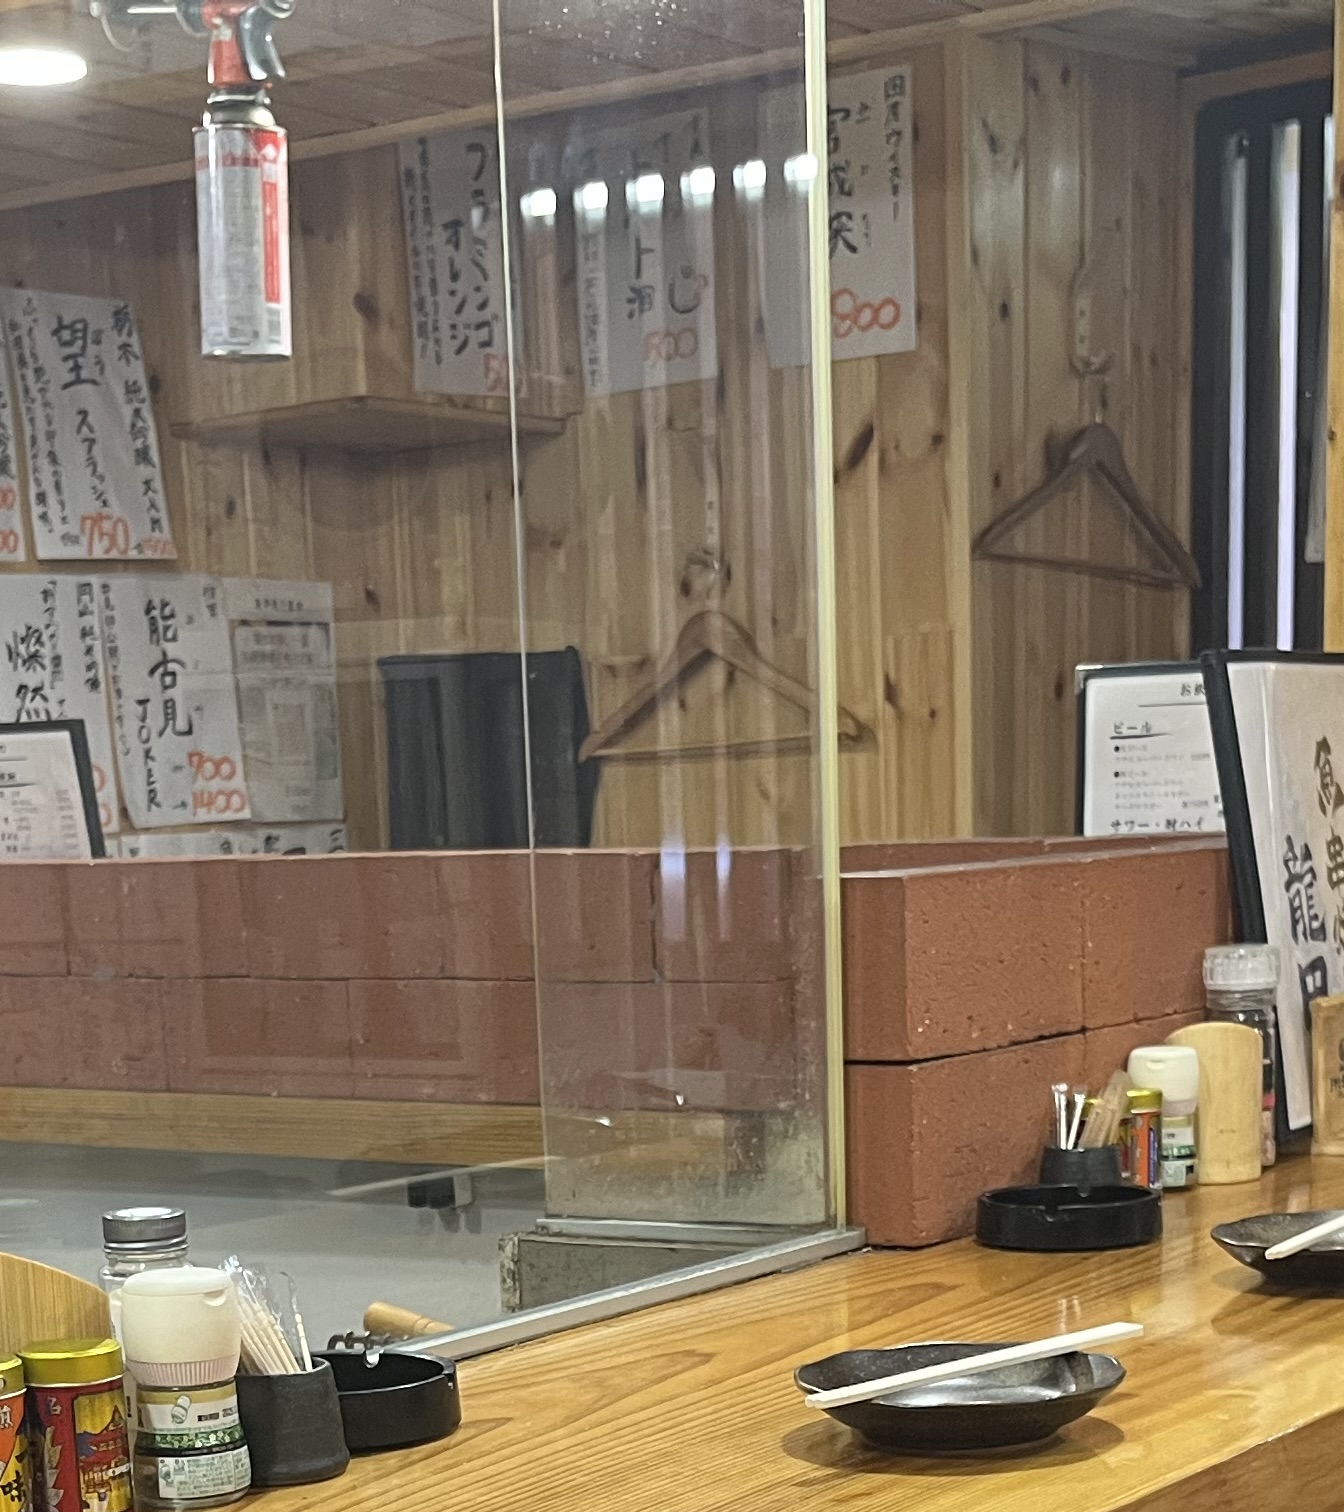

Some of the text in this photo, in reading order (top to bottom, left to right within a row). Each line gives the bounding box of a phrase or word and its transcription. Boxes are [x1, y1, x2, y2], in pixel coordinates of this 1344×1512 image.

[79, 512, 130, 557] 750
[143, 597, 194, 739] 能古見
[186, 750, 238, 783] 700
